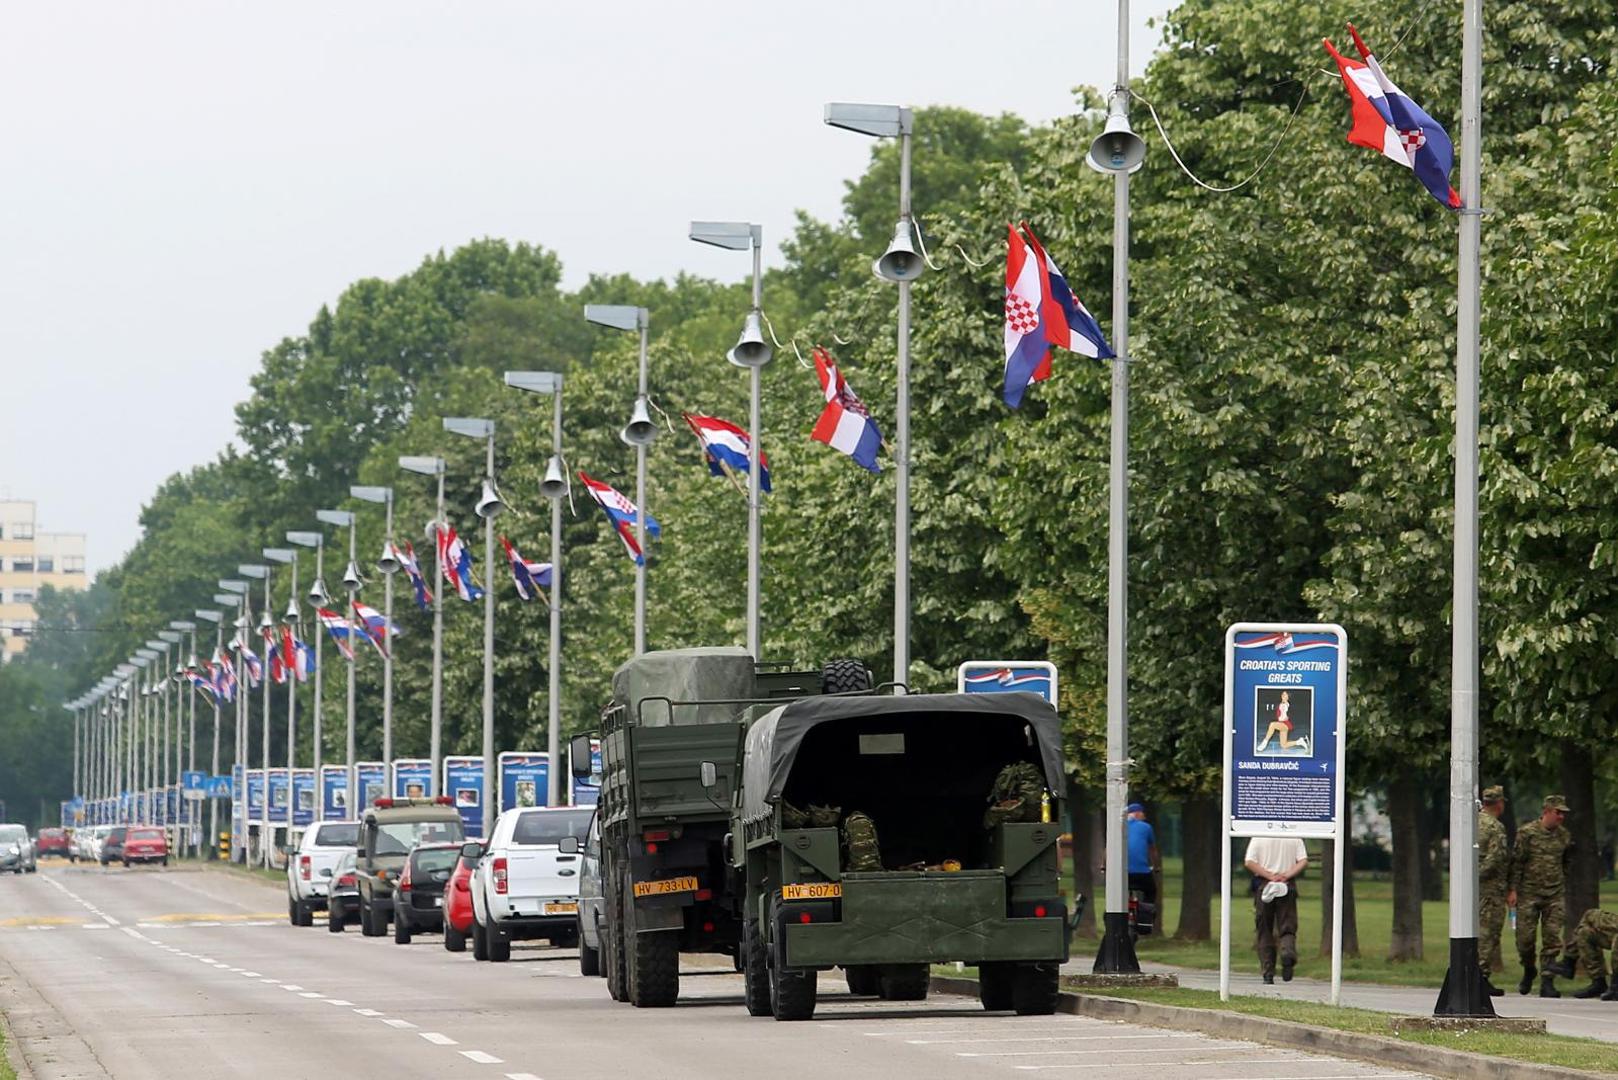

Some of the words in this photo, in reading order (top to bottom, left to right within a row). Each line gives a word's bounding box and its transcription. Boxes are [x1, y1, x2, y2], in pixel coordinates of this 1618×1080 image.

[1240, 659, 1286, 670] CROATIA'S
[1286, 660, 1331, 672] SPORTING
[1268, 673, 1303, 684] GREATS
[1238, 761, 1261, 769] SANDA
[191, 774, 201, 788] P
[639, 884, 651, 894] HV
[788, 886, 800, 898] HV
